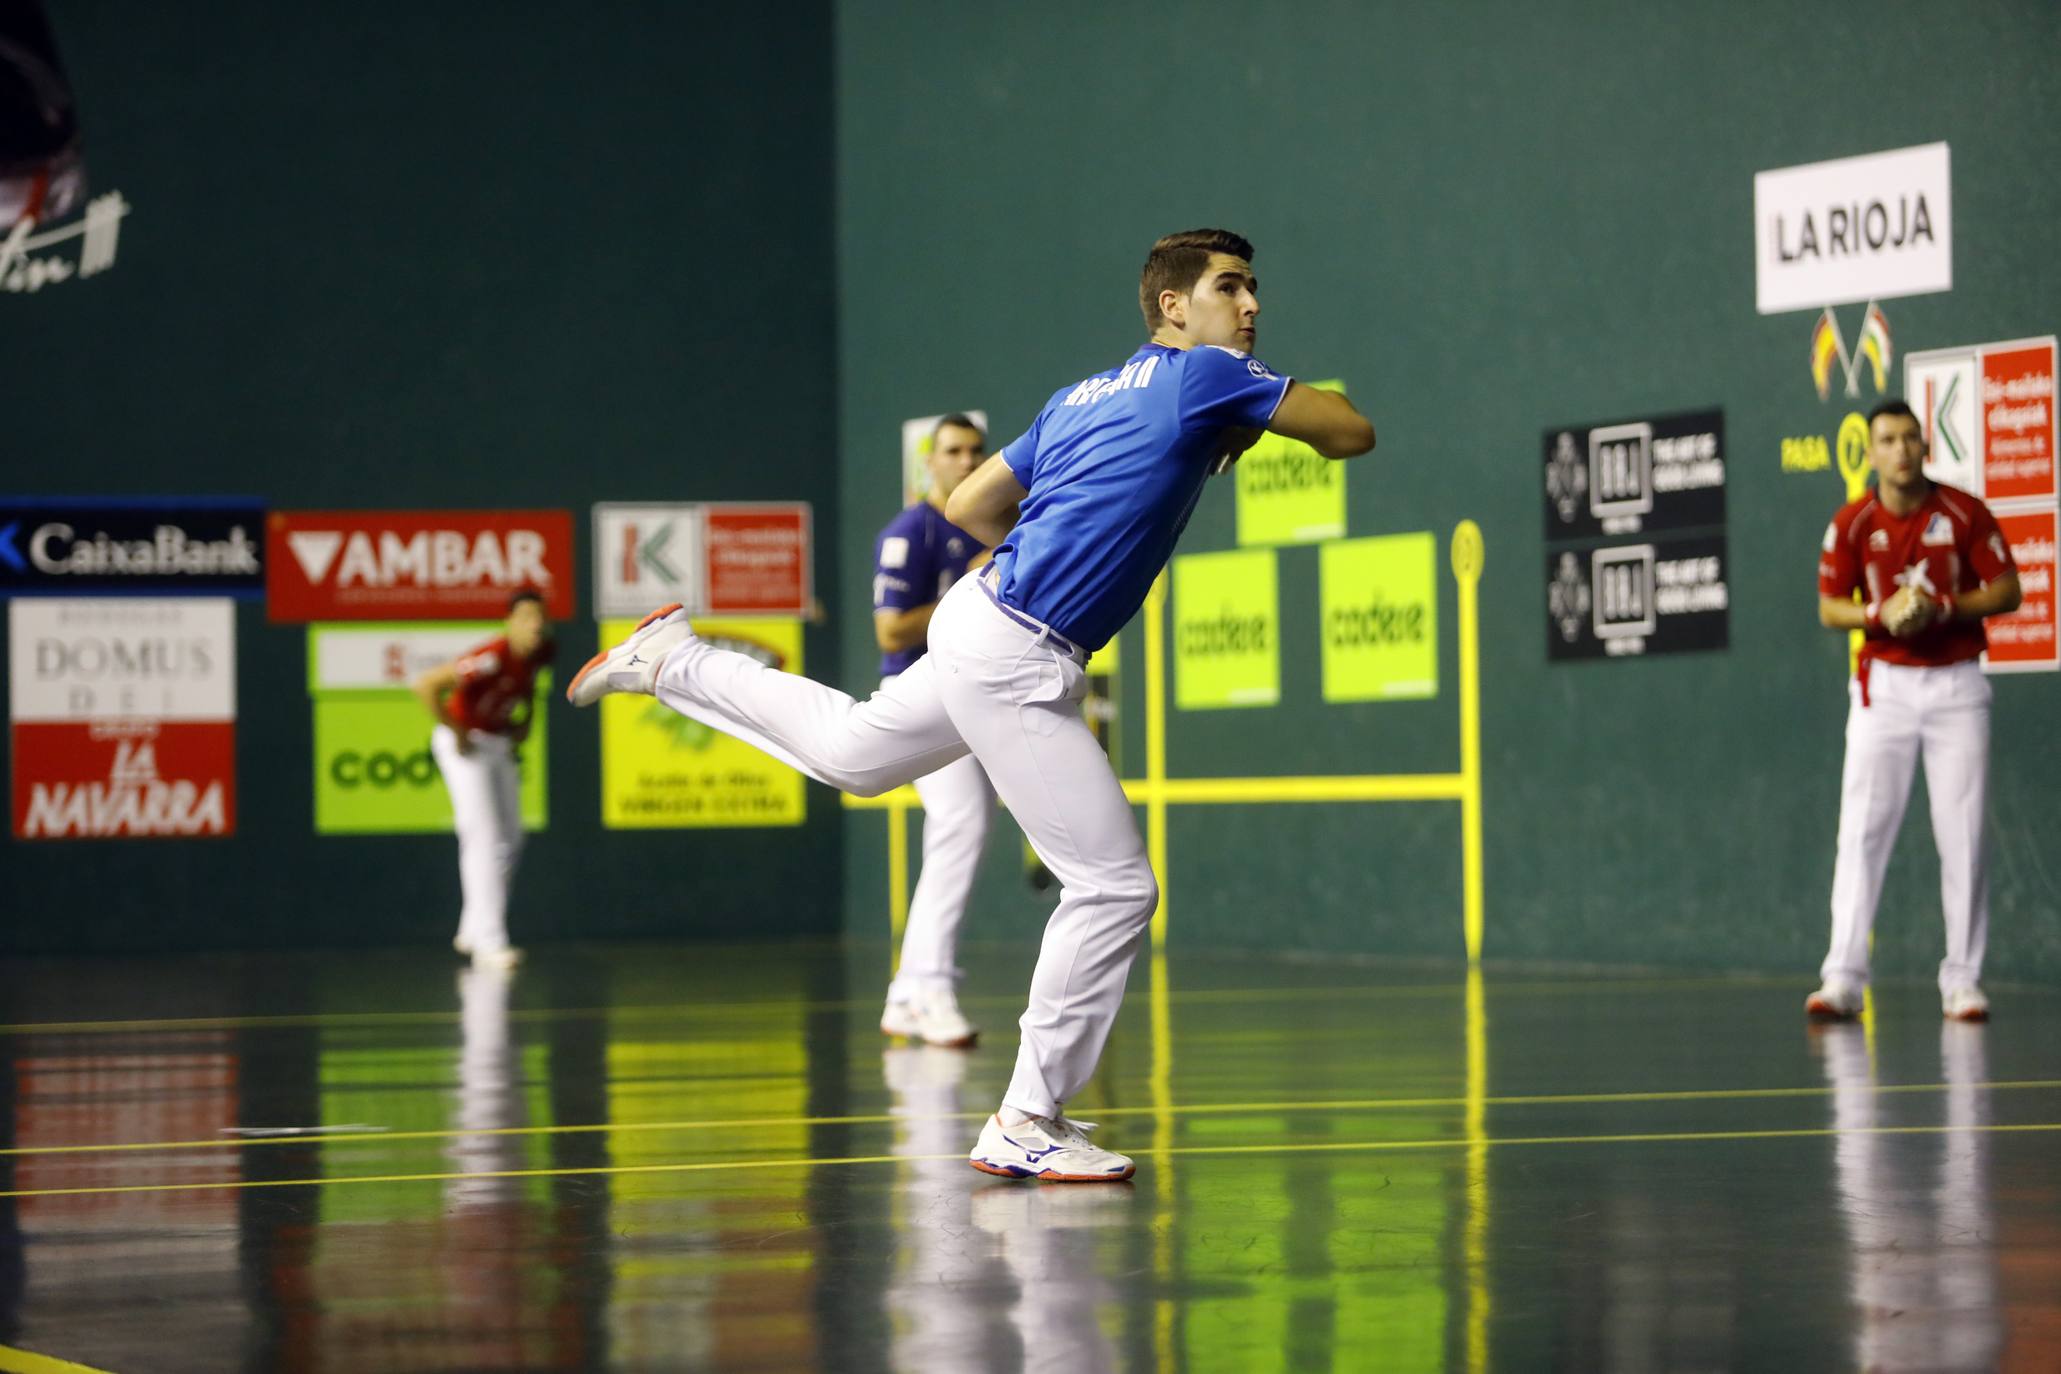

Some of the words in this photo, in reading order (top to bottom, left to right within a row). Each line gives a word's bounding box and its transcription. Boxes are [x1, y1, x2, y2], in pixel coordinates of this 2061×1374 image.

[1776, 211, 1820, 263] LA
[1828, 192, 1935, 256] RIOJA
[28, 522, 260, 577] CaixaBank
[336, 530, 552, 587] AMBAR
[35, 636, 215, 681] DOMUS
[111, 739, 160, 780] LA
[23, 778, 226, 838] NAVARRA
